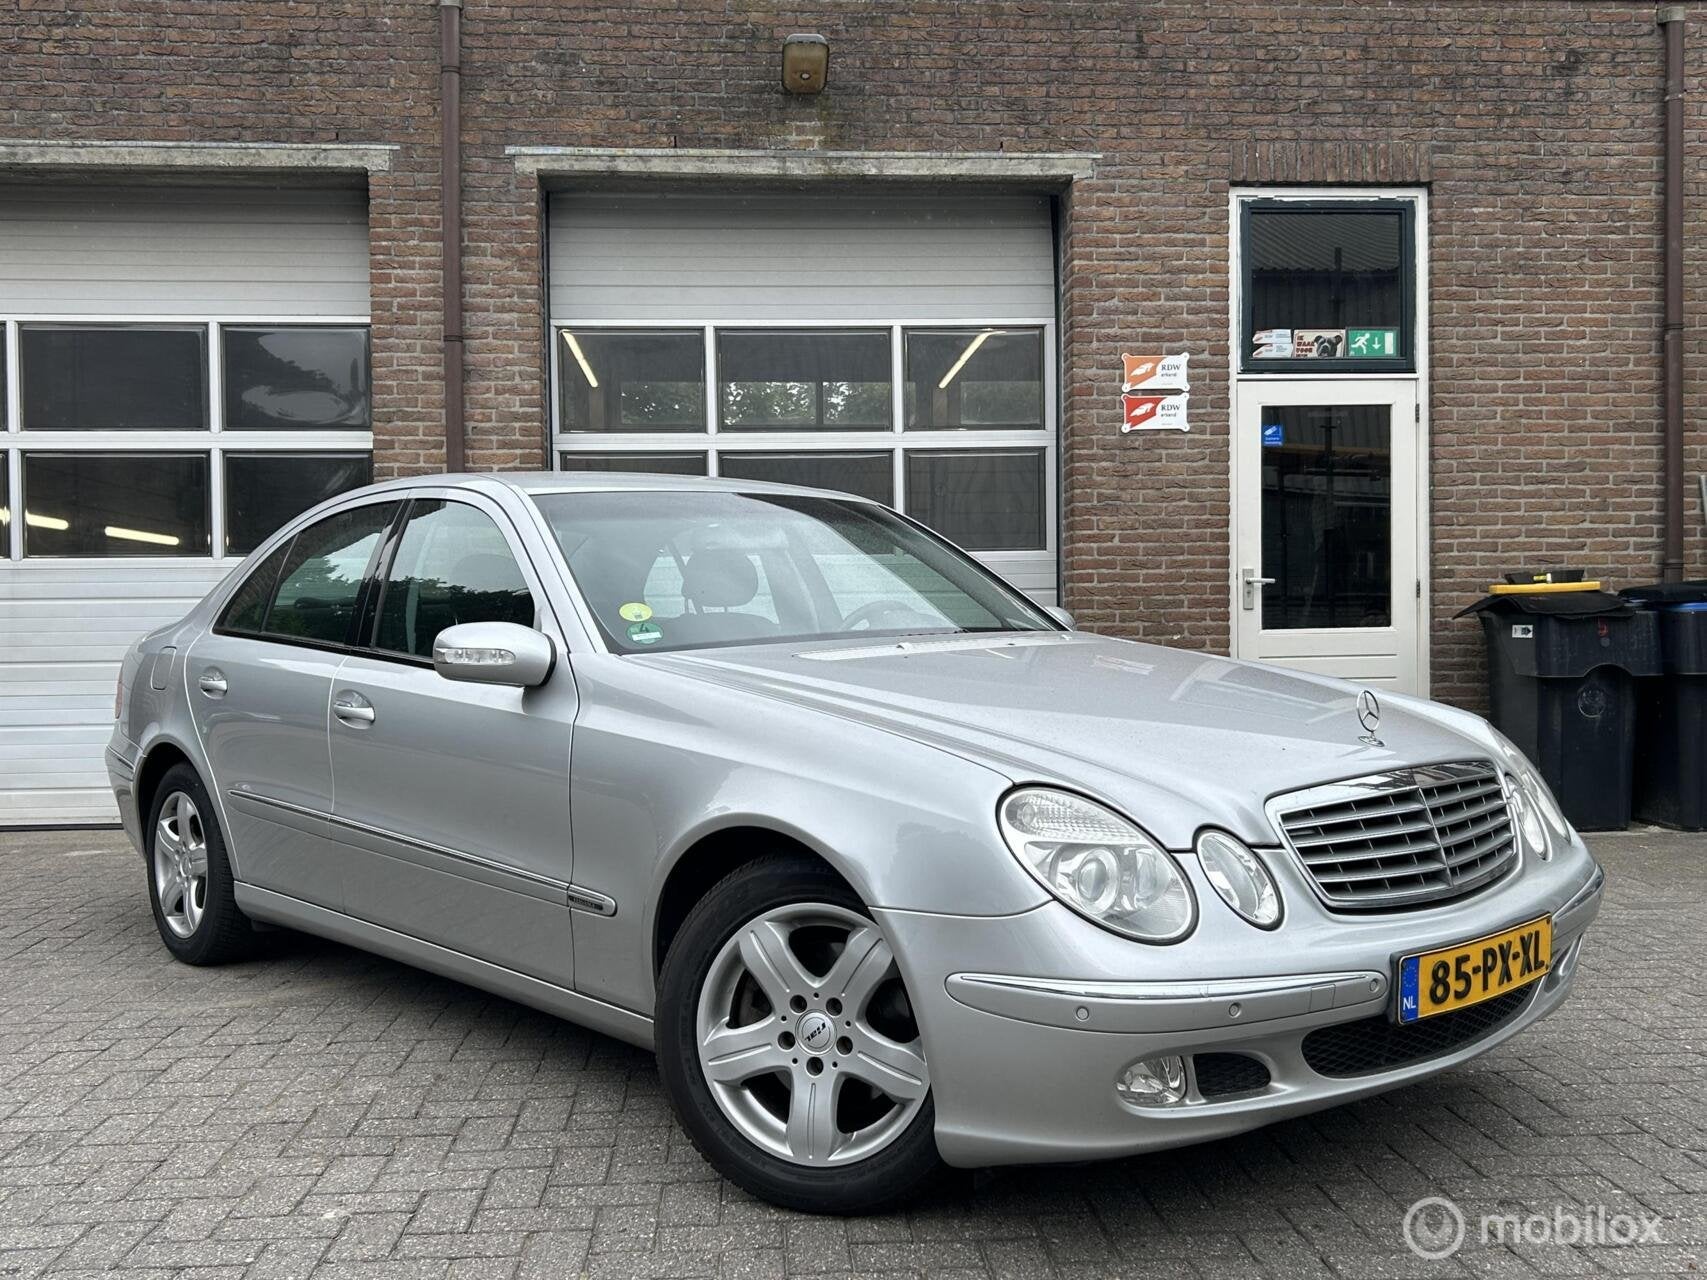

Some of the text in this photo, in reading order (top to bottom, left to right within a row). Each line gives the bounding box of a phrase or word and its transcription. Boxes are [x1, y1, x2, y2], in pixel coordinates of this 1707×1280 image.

[1161, 363, 1181, 371] RDW
[1429, 930, 1545, 1005] 85-PX-XL
[1403, 996, 1416, 1011] NL
